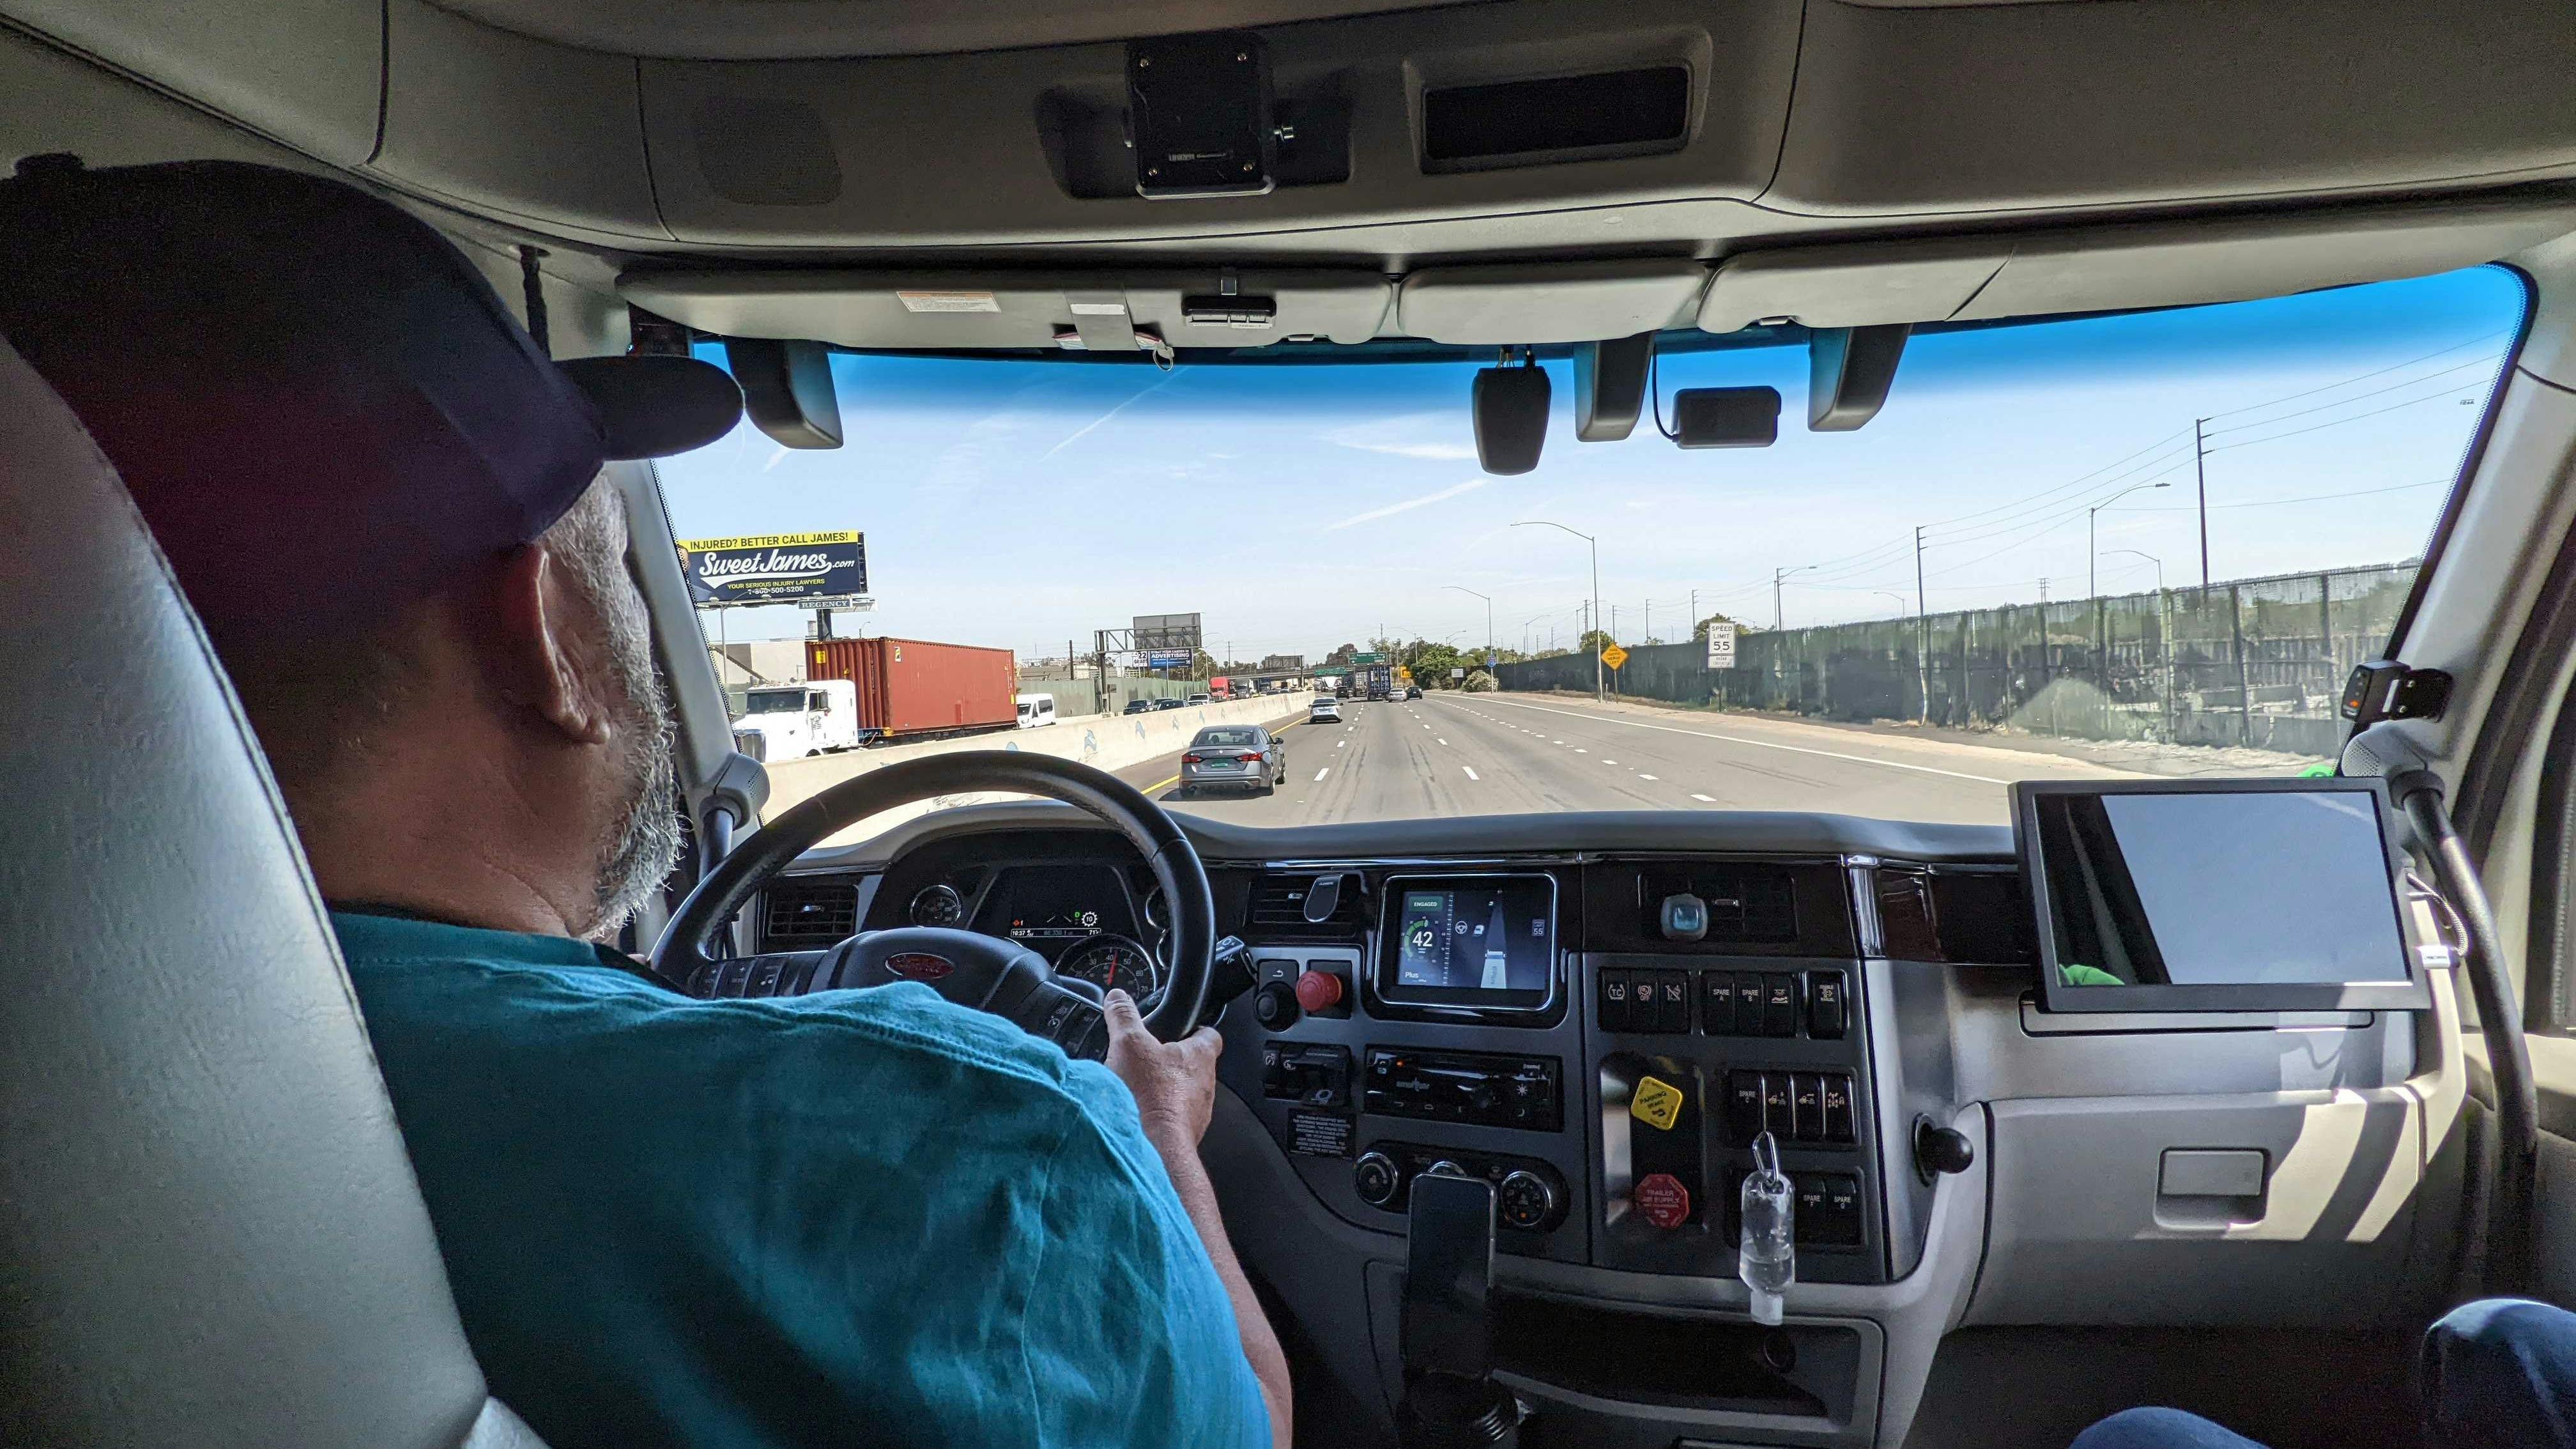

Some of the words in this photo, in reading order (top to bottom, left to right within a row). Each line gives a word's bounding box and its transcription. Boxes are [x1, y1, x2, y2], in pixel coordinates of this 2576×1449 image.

[690, 539, 737, 550] INJURED?
[740, 536, 779, 547] BETTER
[782, 535, 808, 544] CALL
[810, 532, 848, 543] JAMES!
[1713, 641, 1730, 650] 55
[1412, 931, 1433, 947] 42
